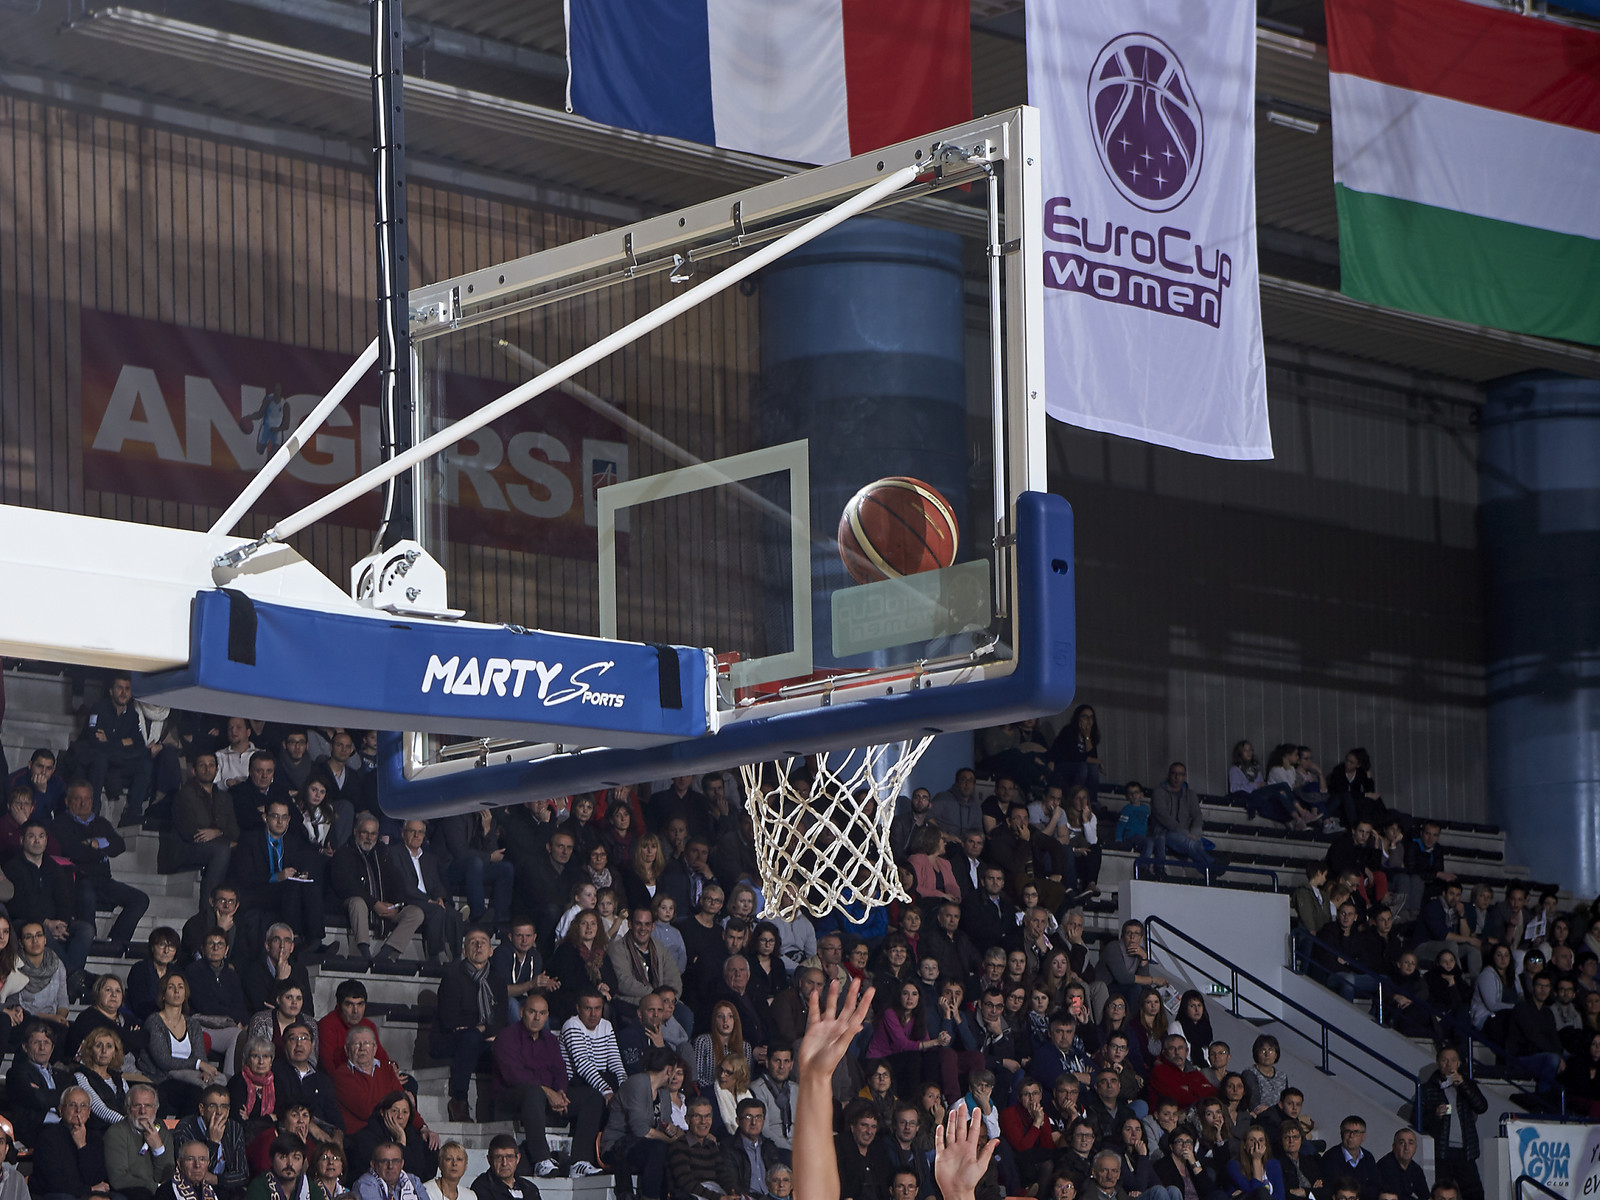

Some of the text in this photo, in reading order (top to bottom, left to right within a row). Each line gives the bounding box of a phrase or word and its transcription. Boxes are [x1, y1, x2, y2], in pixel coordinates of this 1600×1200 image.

[1044, 196, 1231, 291] EuroCup
[92, 364, 572, 519] ANGRS
[421, 654, 563, 700] MARTY
[1528, 1157, 1569, 1185] GYM
[1530, 1141, 1570, 1160] AQUA
